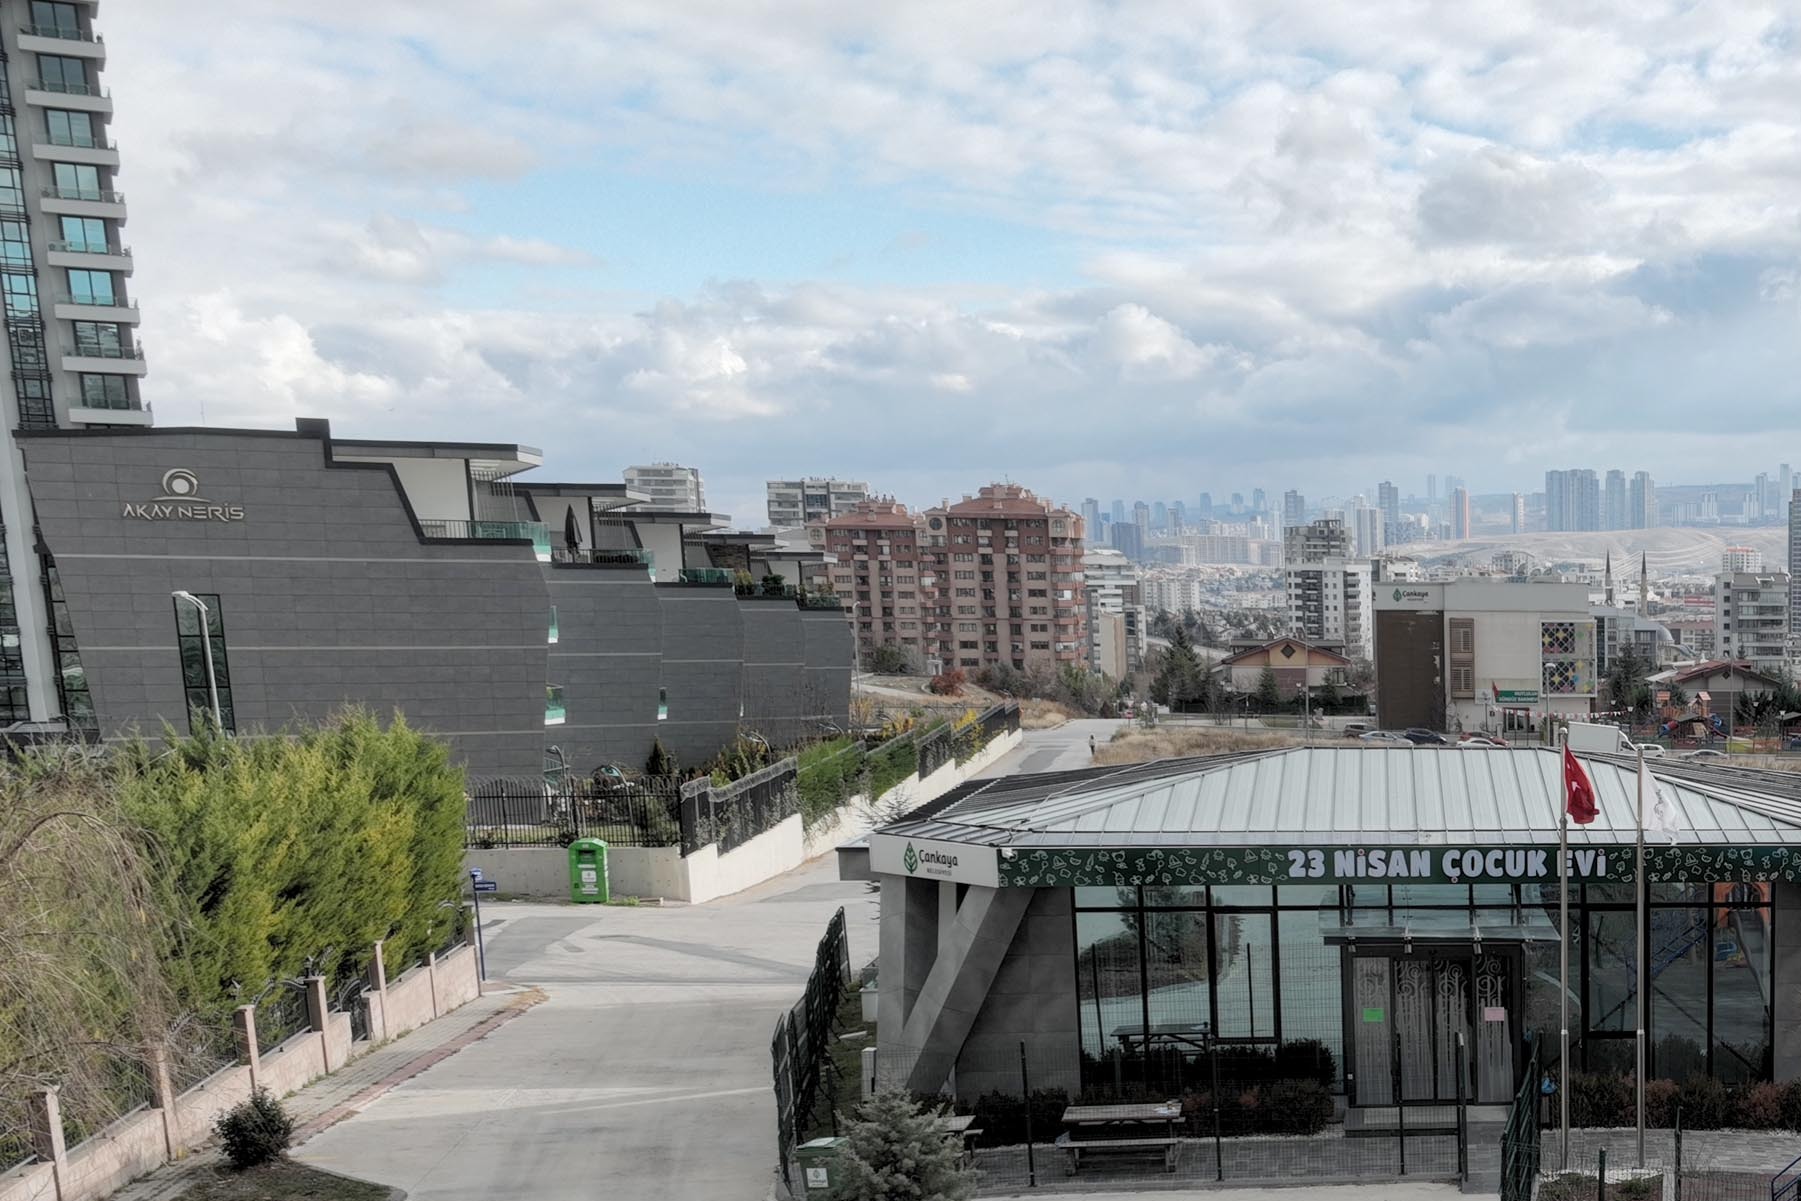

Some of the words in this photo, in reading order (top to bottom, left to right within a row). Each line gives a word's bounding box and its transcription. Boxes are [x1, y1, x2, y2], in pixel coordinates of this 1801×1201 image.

[123, 503, 173, 521] AKAY
[918, 849, 959, 868] Çankaya
[1287, 849, 1326, 878] 23
[1441, 849, 1548, 884] ÇOCUK
